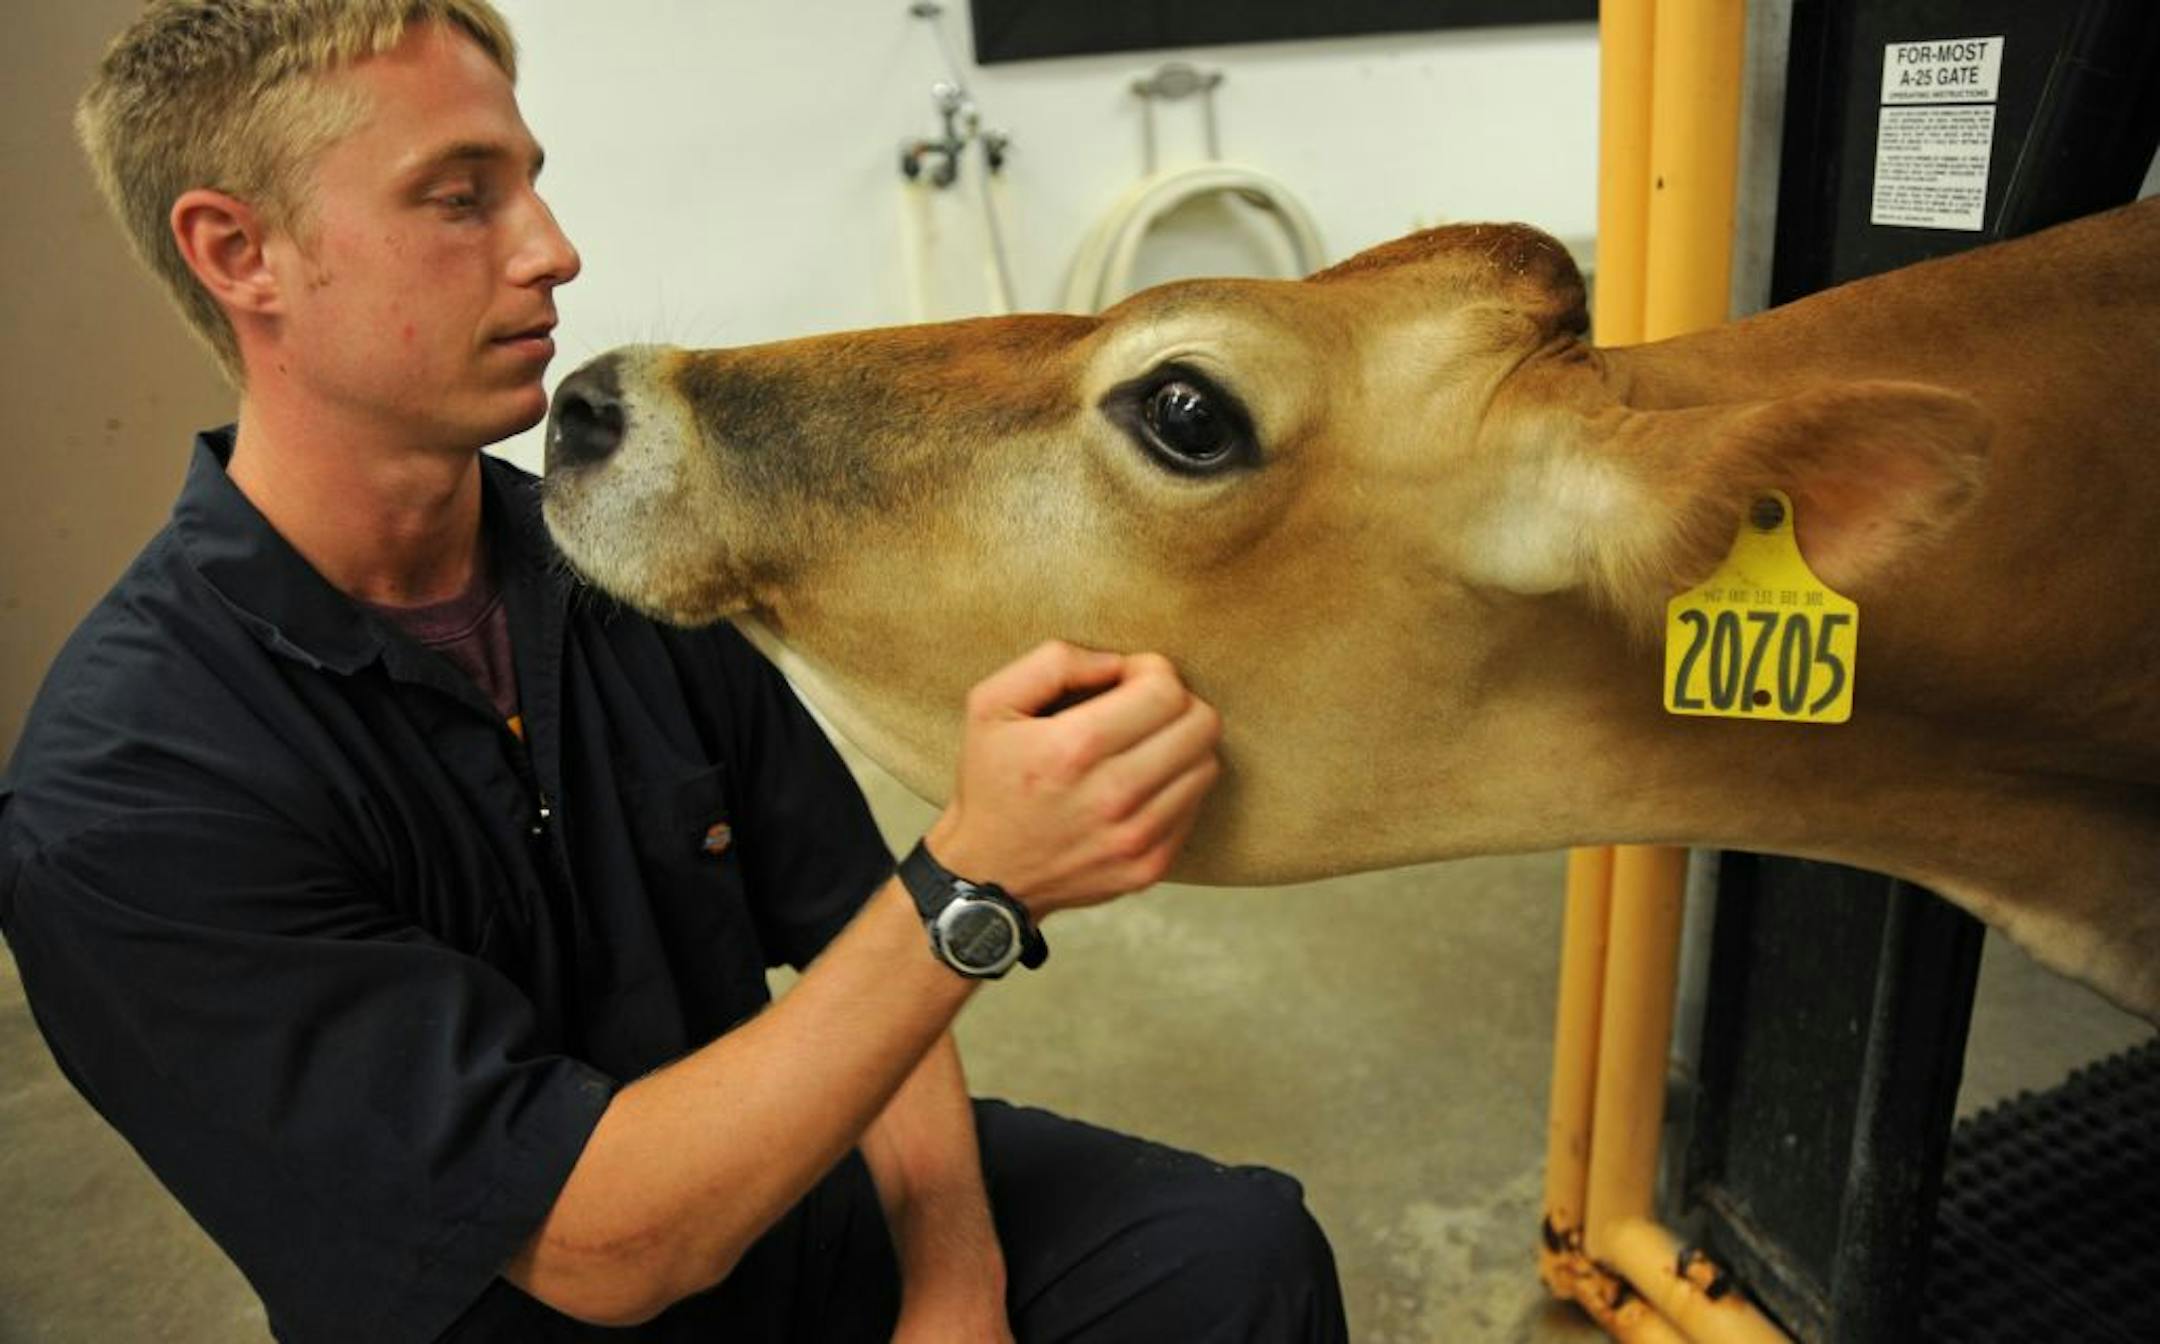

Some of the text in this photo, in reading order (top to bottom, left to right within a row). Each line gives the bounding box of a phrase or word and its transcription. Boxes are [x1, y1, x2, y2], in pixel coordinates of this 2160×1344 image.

[1897, 42, 1989, 64] FOR-MOST
[1900, 66, 1980, 86] A-25 GATE
[1673, 609, 1851, 716] 20705
